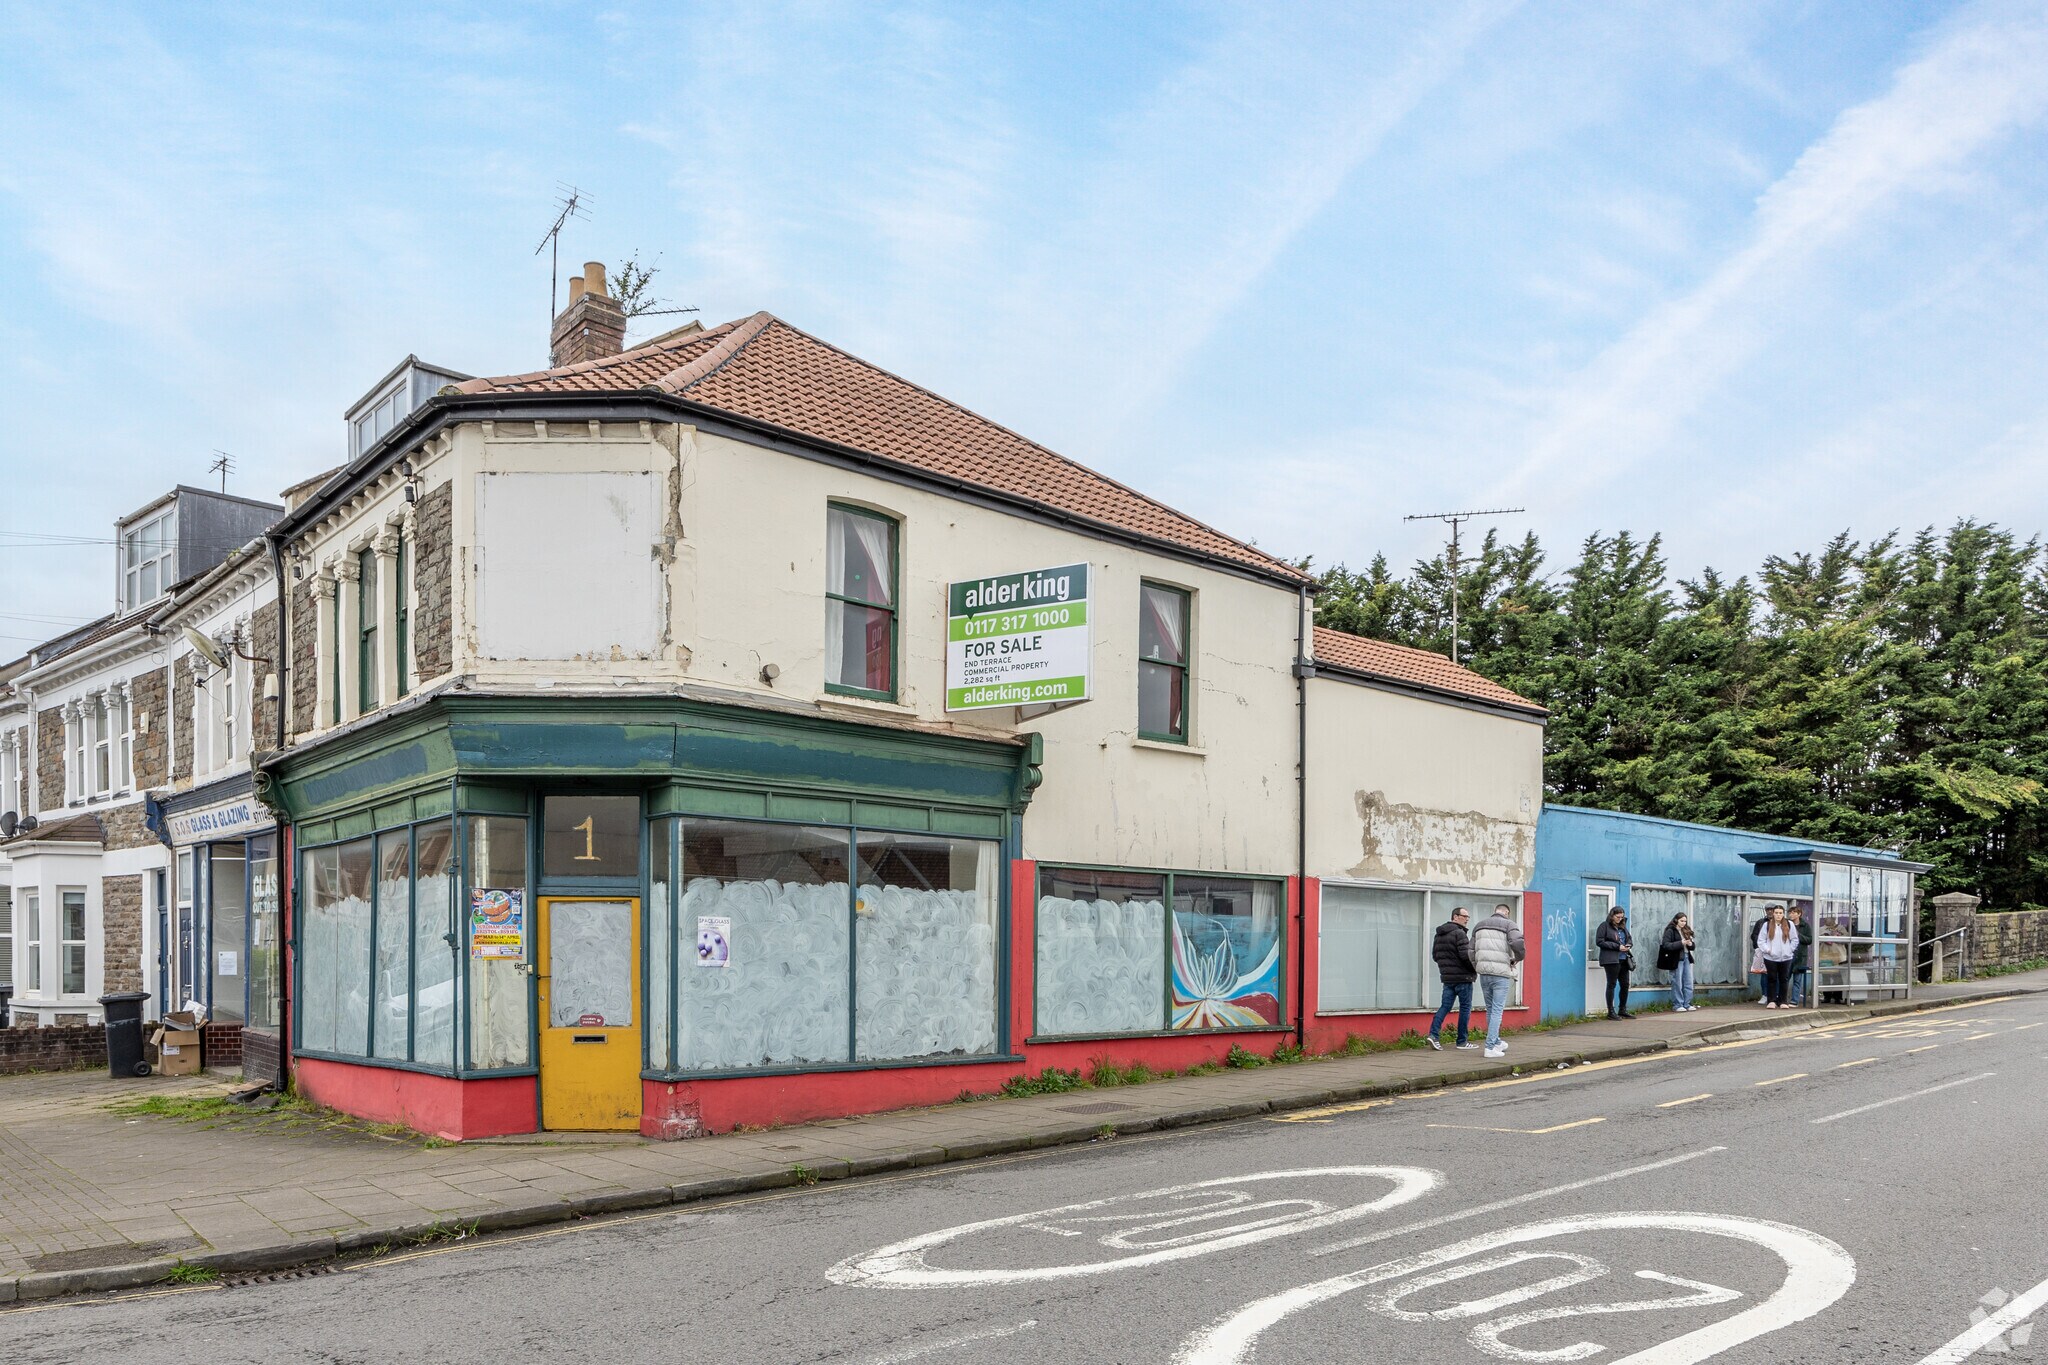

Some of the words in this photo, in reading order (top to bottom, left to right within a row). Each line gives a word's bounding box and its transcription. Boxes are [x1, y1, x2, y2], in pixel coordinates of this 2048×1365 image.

[965, 579, 1020, 608] alder
[1023, 572, 1070, 601] king
[964, 618, 996, 636] 0117
[1001, 614, 1027, 631] 317
[1032, 608, 1070, 627] 1000
[964, 641, 995, 658] FOR
[1000, 635, 1042, 654] SALE
[964, 660, 979, 669] END
[980, 656, 1012, 667] TERRACE
[964, 665, 1009, 676] COMMERCIAL
[1011, 660, 1049, 671] PROPERTY
[964, 676, 984, 685] 2,282
[985, 675, 993, 683] sq
[994, 674, 1000, 682] ft
[963, 682, 1068, 704] alderking.com
[190, 814, 212, 833] GLASS
[211, 813, 218, 829] &
[218, 804, 251, 828] GLAZING
[572, 815, 602, 861] 1
[252, 901, 262, 914] CUT
[264, 901, 271, 913] TO
